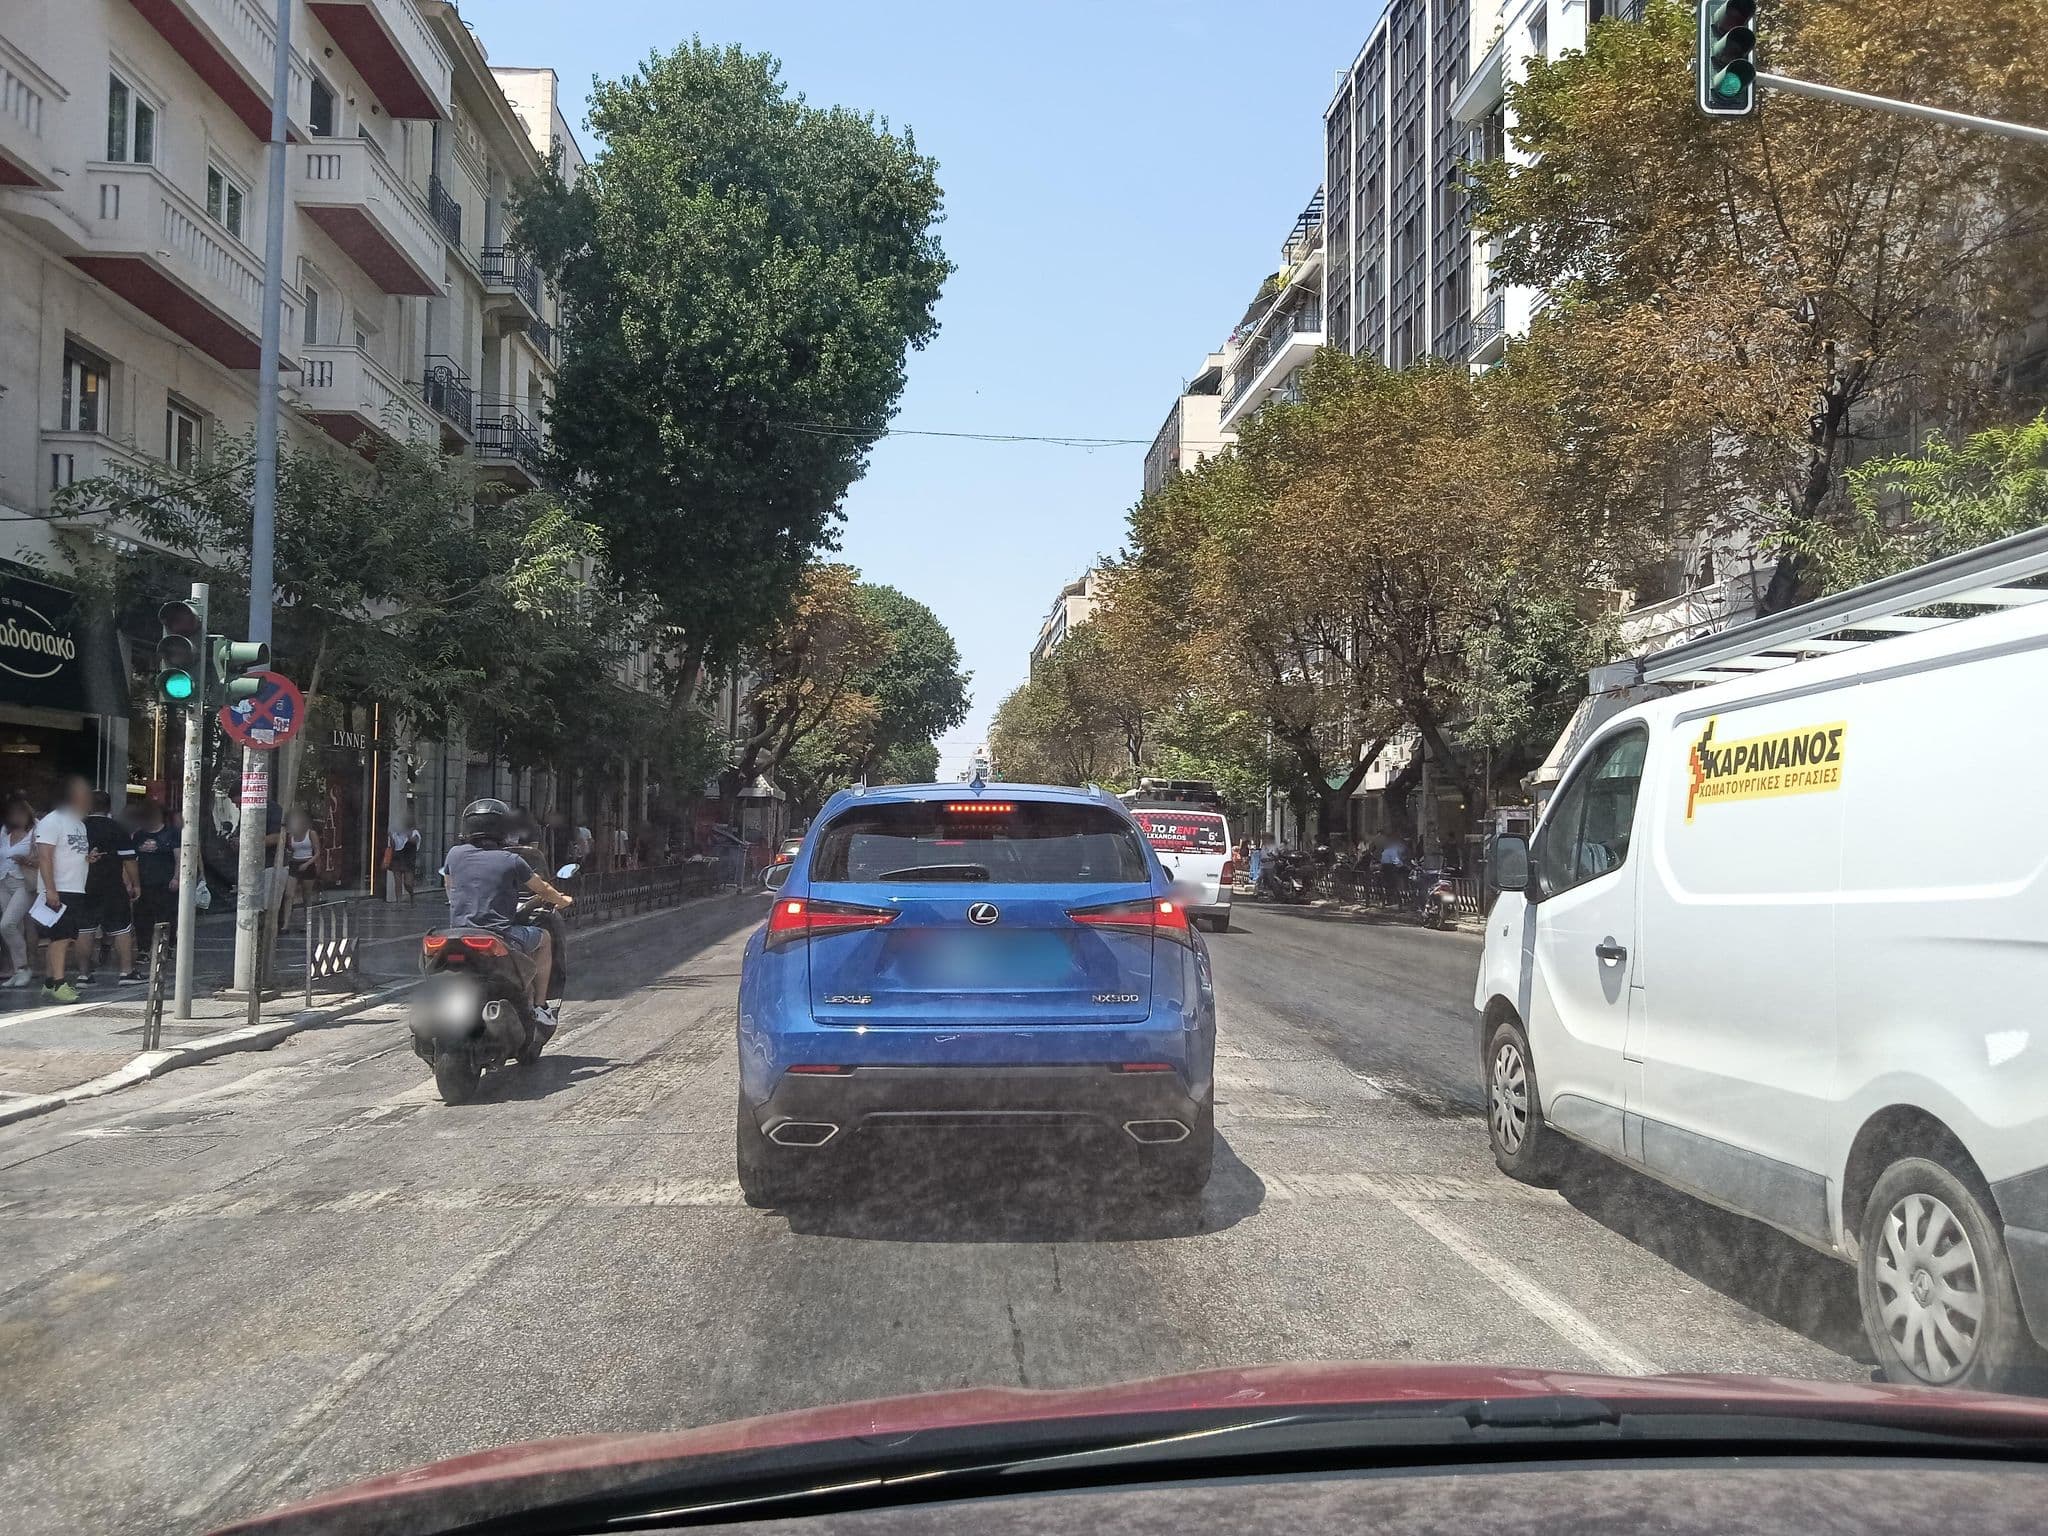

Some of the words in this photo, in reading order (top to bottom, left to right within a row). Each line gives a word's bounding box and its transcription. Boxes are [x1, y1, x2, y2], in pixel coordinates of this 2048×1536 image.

[333, 730, 366, 749] LYNNE
[1705, 728, 1843, 779] ΚΑΡΑΝΑΝΟΣ
[1699, 775, 1781, 798] ΧΩΜΑΤΟΥΡΓΙΚΕΣ
[1785, 768, 1838, 788] ΕΡΓΑΣΙΕΣ
[1141, 824, 1167, 834] OTO
[1169, 826, 1199, 836] RENT
[1145, 833, 1187, 841] LEXANDROS
